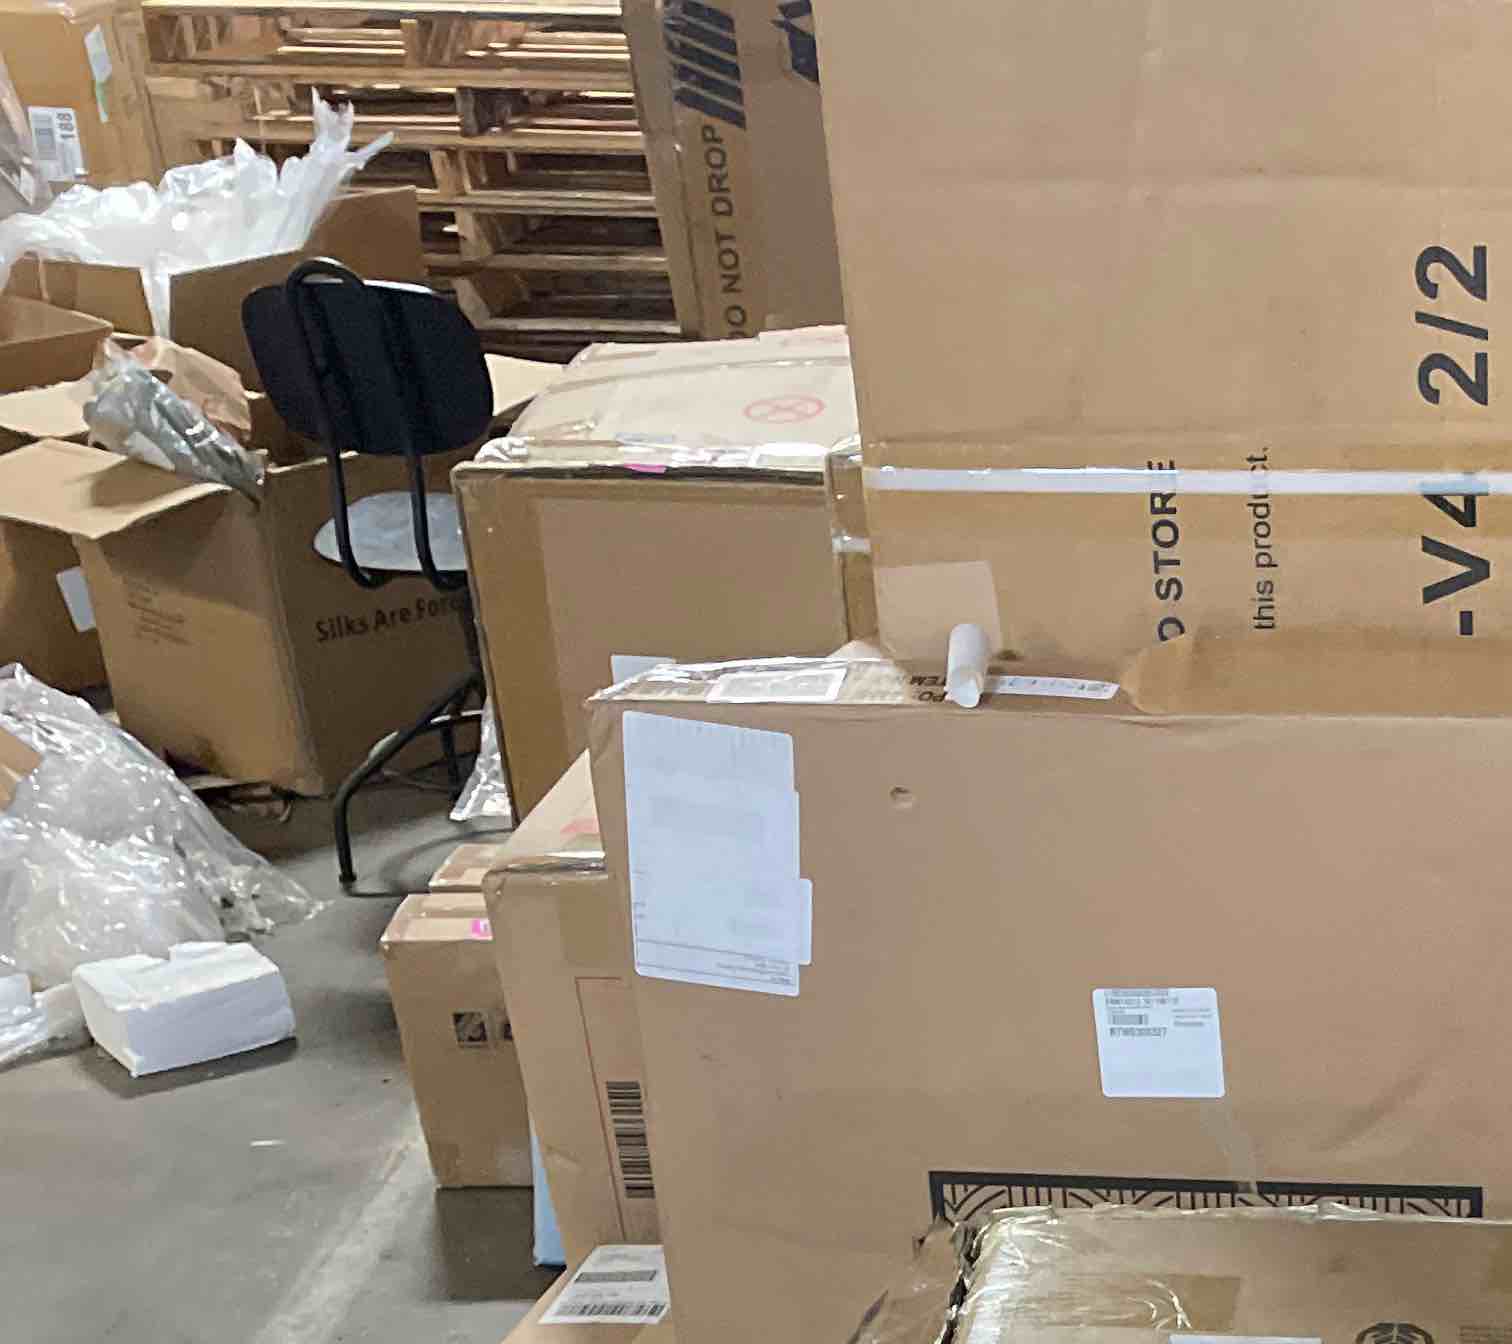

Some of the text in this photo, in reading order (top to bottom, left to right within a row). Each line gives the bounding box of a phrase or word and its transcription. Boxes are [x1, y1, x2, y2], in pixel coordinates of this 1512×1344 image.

[701, 123, 735, 217] DROP
[716, 229, 747, 294] NOT
[1414, 245, 1490, 407] 2/2
[1246, 446, 1279, 631] this prodt.
[315, 615, 369, 643] Silks
[373, 606, 412, 632] Are
